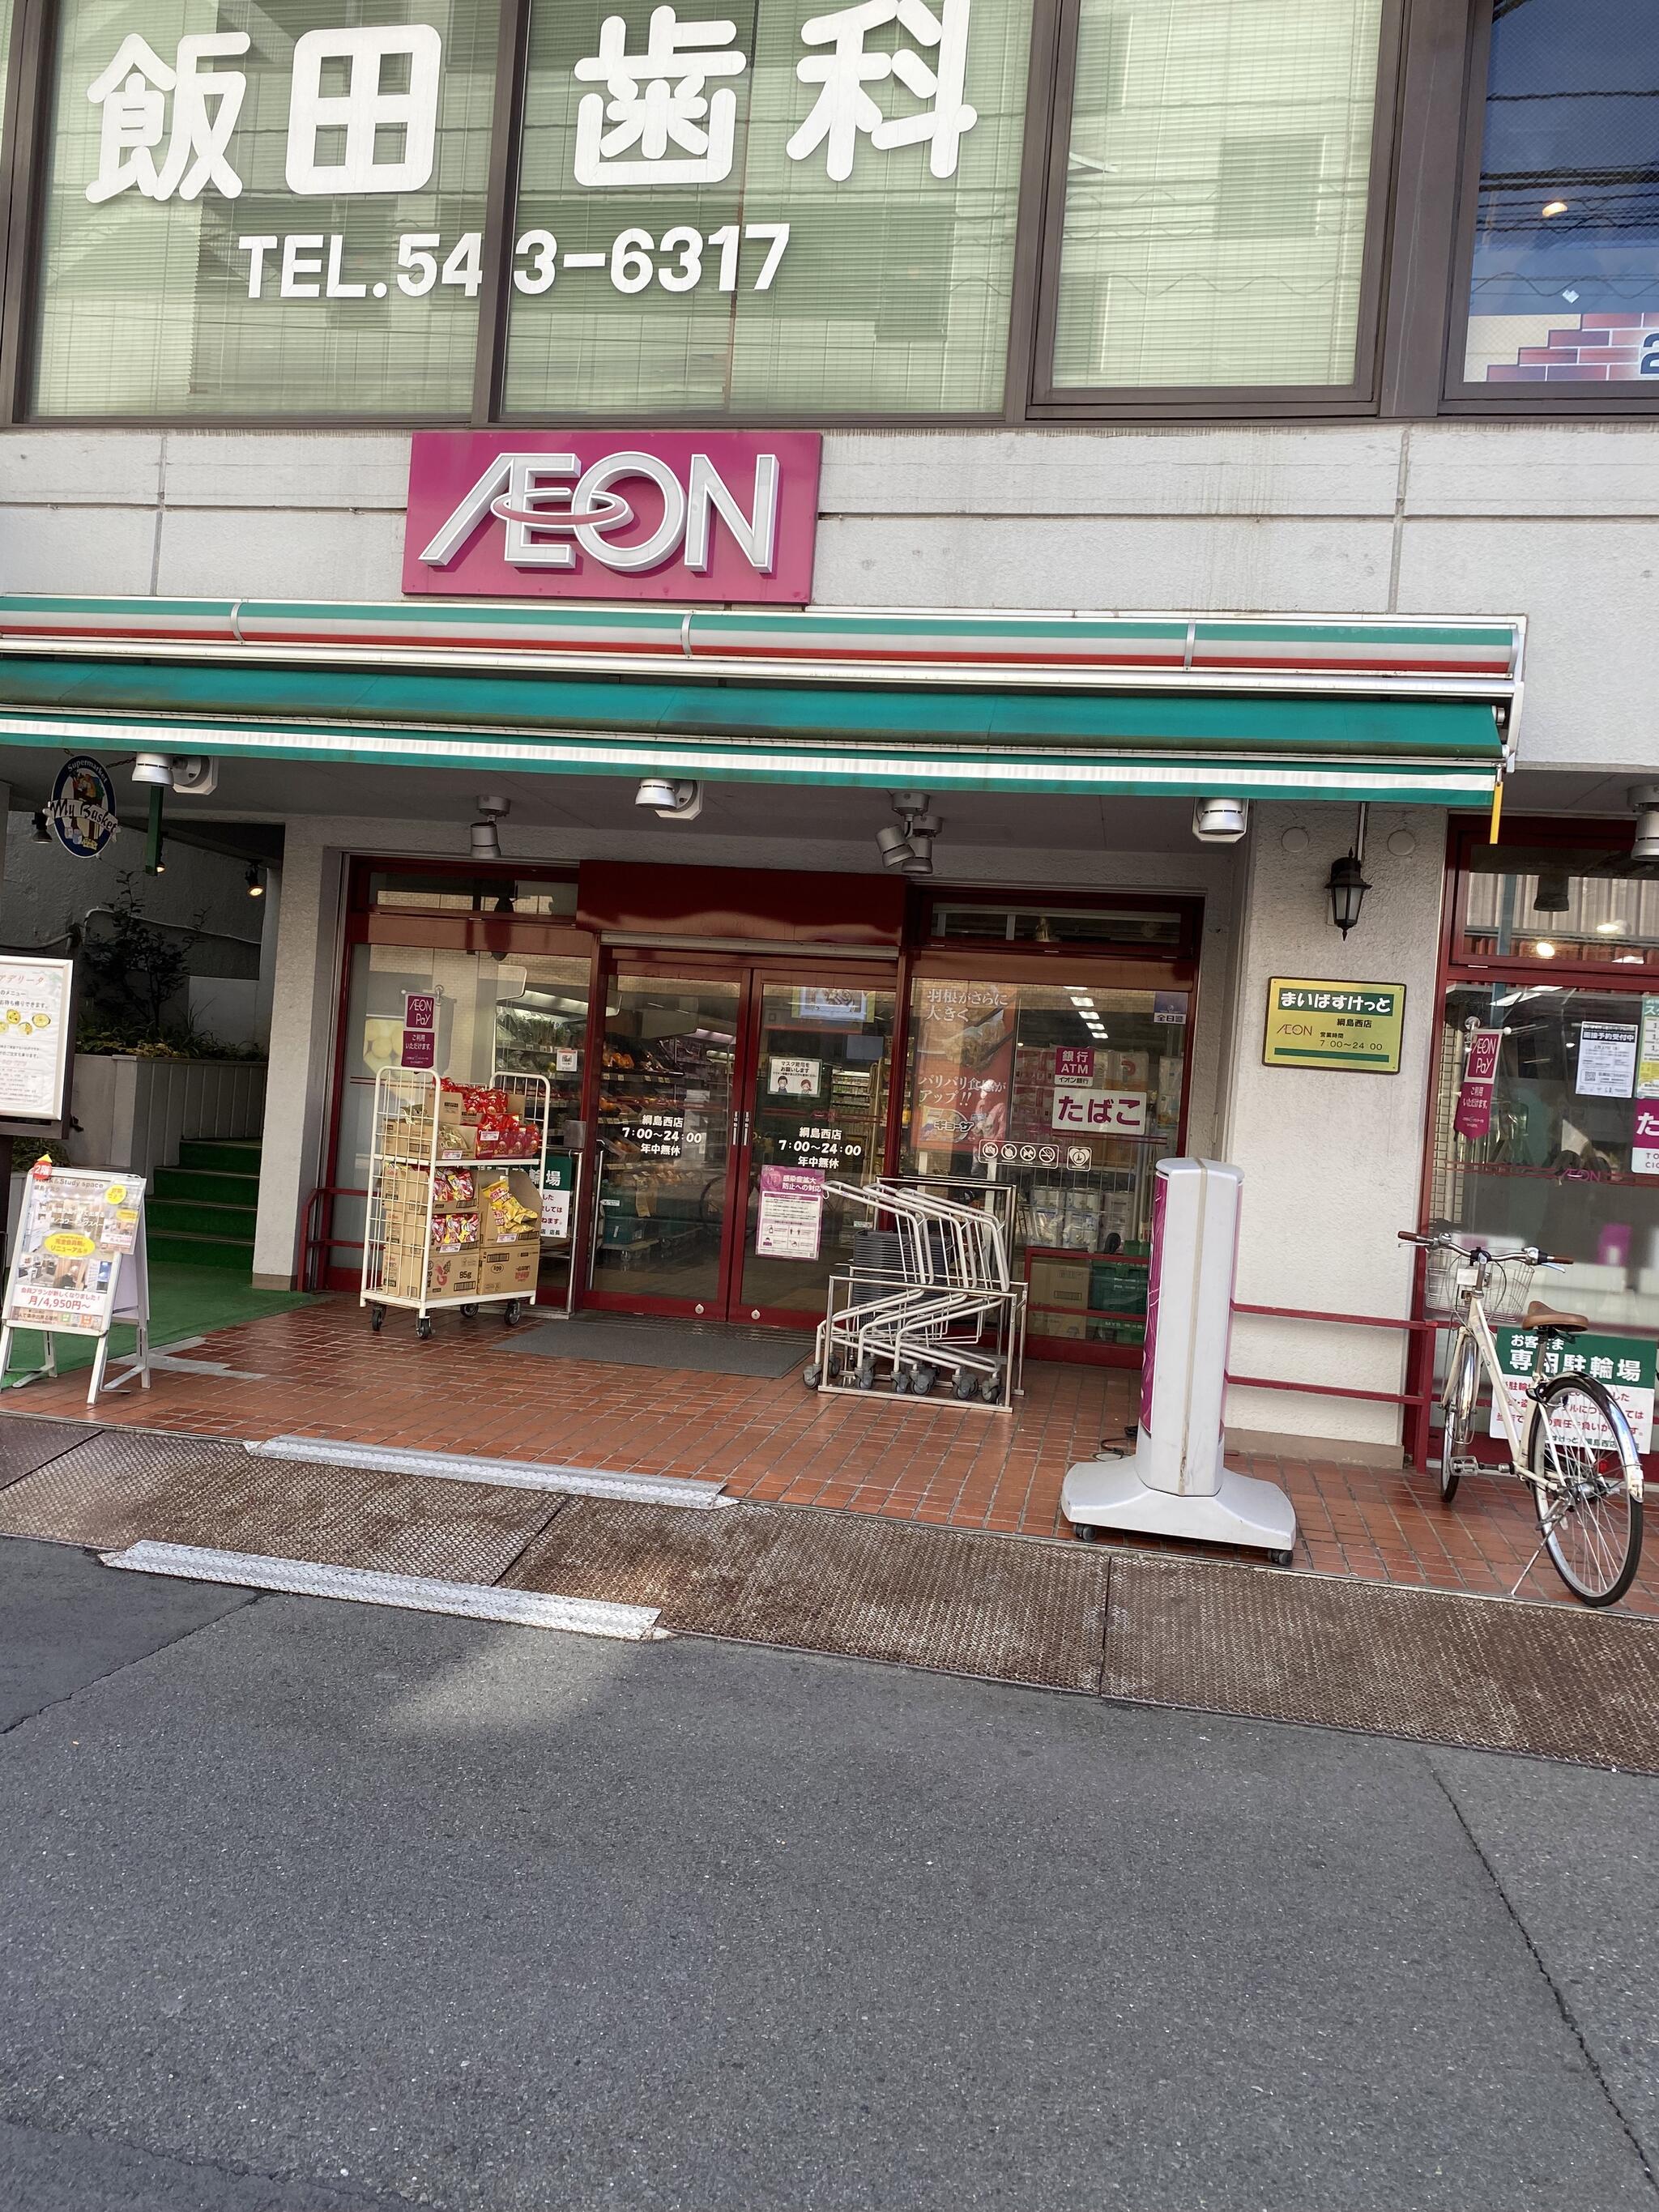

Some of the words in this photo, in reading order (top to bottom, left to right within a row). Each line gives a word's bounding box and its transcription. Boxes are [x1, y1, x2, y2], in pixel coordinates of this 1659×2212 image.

[84, 23, 441, 202] 飯田
[574, 0, 979, 187] 歯科
[419, 451, 780, 573] AEON
[68, 760, 108, 783] Supermarket
[50, 799, 75, 818] My
[80, 801, 117, 833] Basket
[927, 989, 1008, 1006] 羽根がさらに
[1281, 991, 1391, 1013] まいばすけっと
[409, 999, 433, 1012] AEON
[926, 1005, 970, 1022] 大きく
[1277, 1024, 1312, 1036] AEON
[1337, 1018, 1372, 1029] 綱島西店
[1472, 1038, 1496, 1055] AEON
[1062, 1051, 1089, 1063] 銀行
[1060, 1063, 1089, 1074] ATM
[1059, 1076, 1089, 1085] イオン銀行
[1058, 1096, 1141, 1126] たばこ
[642, 1115, 684, 1127] 綱島西店
[934, 1119, 975, 1132] ギョーザ
[799, 1127, 842, 1140] 綱島西店
[641, 1143, 681, 1157] 年中無休
[798, 1156, 840, 1169] 年中無休
[782, 1183, 821, 1192] 防止への対応
